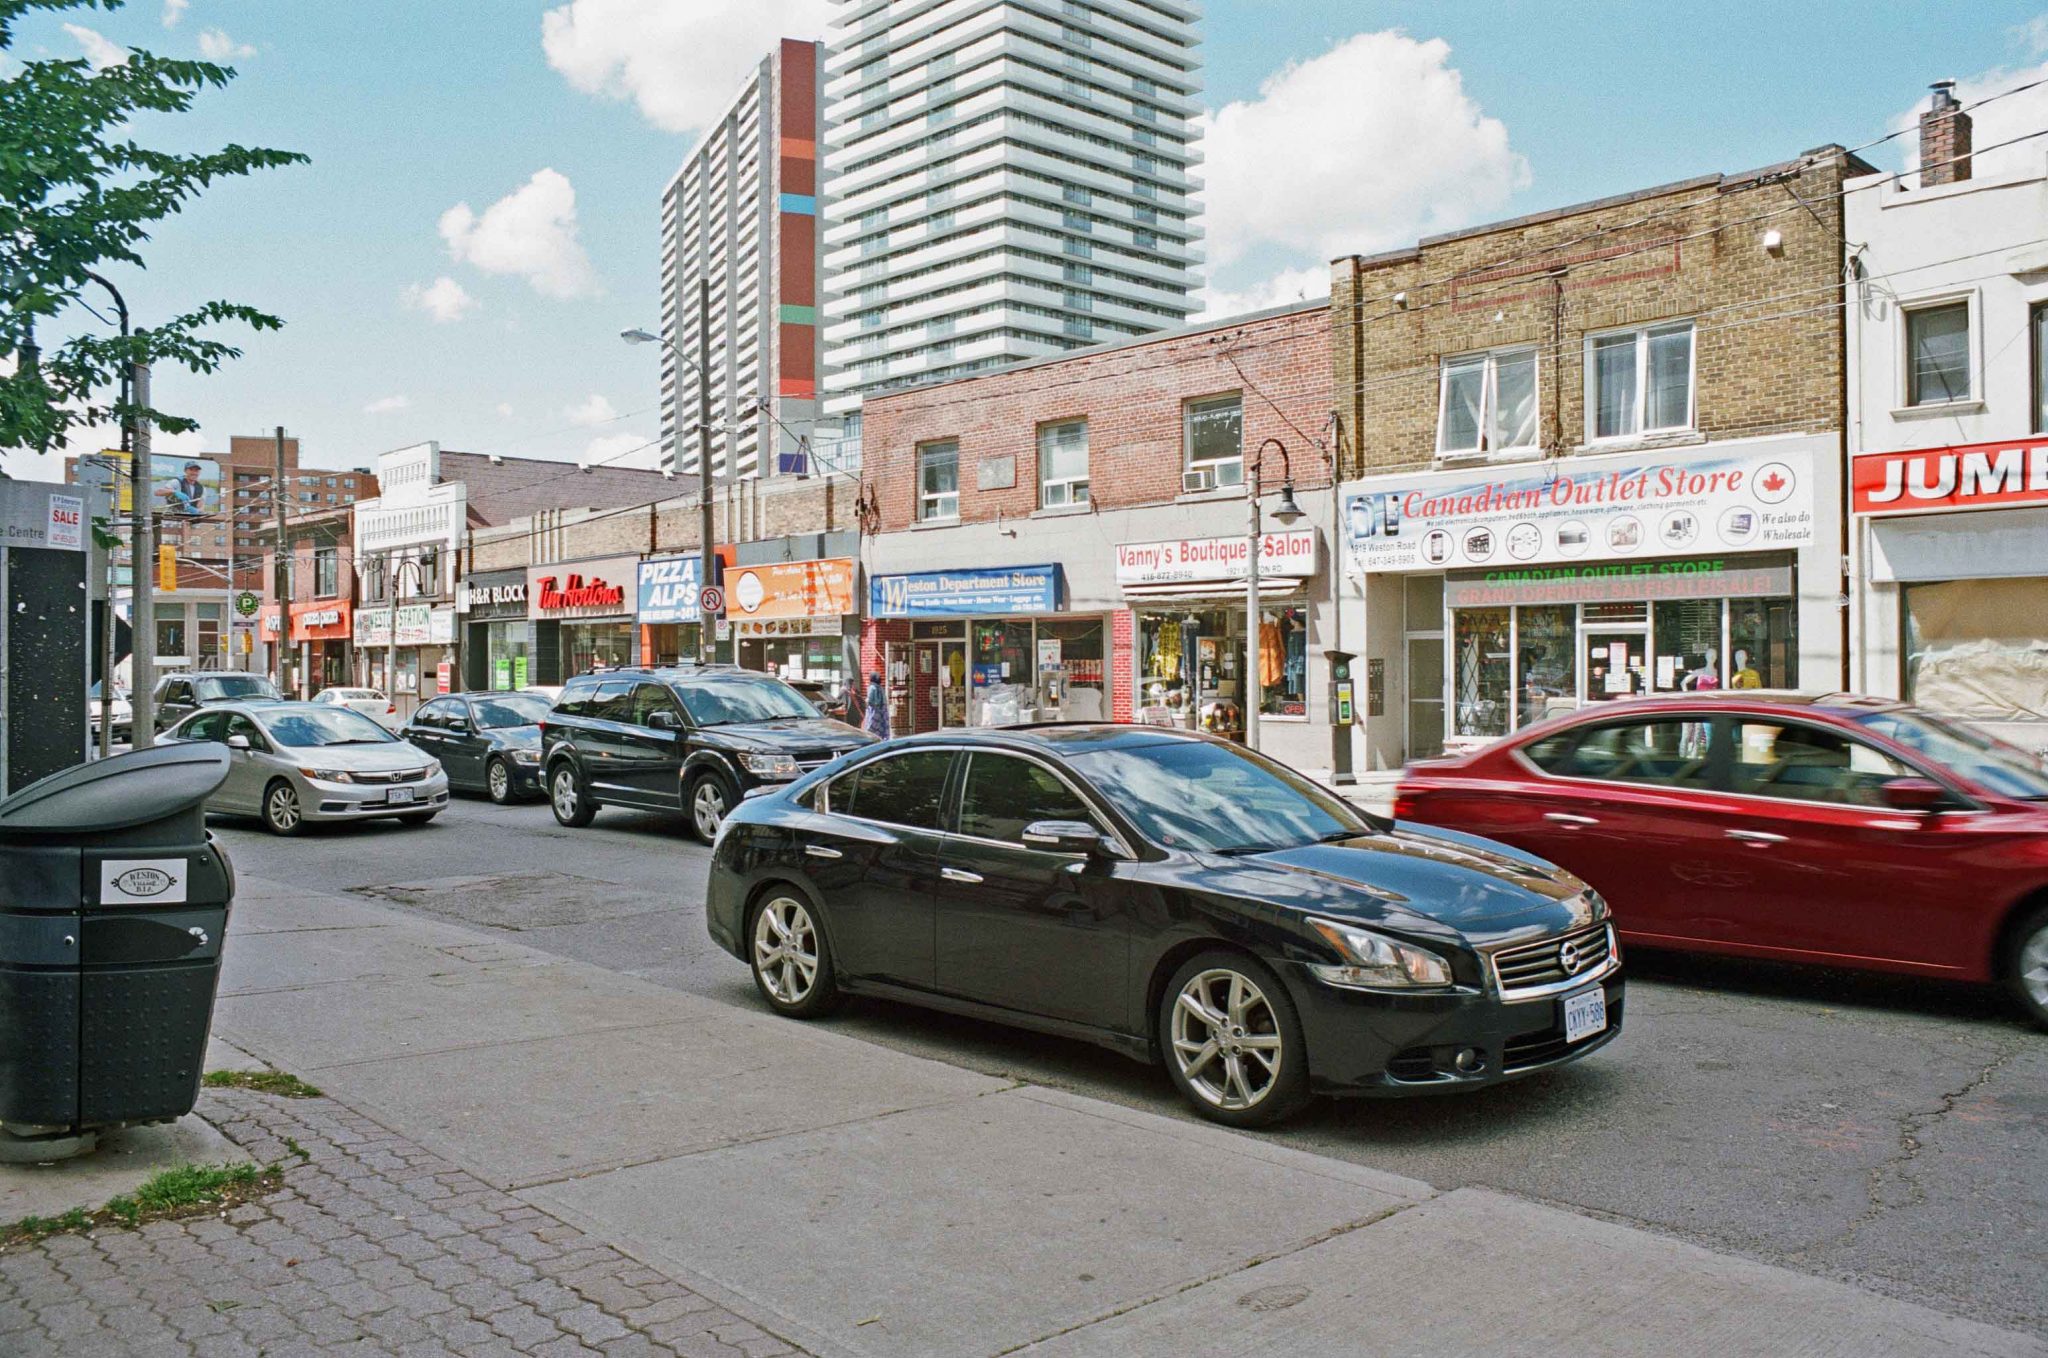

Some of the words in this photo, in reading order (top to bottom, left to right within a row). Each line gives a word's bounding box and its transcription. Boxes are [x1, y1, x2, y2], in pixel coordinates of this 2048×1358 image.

[1404, 484, 1541, 518] Canadian
[1551, 472, 1649, 506] Outlet
[1655, 467, 1743, 497] Store
[53, 510, 79, 525] SALE
[1762, 513, 1776, 524] We
[1779, 512, 1795, 523] also
[1798, 512, 1810, 522] do
[9, 525, 45, 539] Centre
[1763, 528, 1811, 541] Wholesale
[1119, 544, 1172, 569] Vanny's
[1180, 539, 1247, 566] Boutique
[1264, 533, 1311, 557] Salon
[1368, 543, 1394, 552] Weston
[1397, 540, 1416, 550] Road
[640, 560, 695, 585] PIZZA
[939, 574, 1008, 593] Department
[1012, 572, 1046, 586] Store
[1484, 567, 1577, 587] CANADIAN
[1582, 564, 1653, 582] OUTLET
[1658, 560, 1724, 579] STORE
[469, 588, 490, 605] H&R
[493, 584, 525, 602] BLOCK
[536, 576, 562, 609] Tim
[562, 573, 620, 608] Hortons
[648, 582, 699, 607] ALPS
[1457, 587, 1518, 604] GRAND
[1523, 583, 1604, 600] OPENING
[370, 610, 392, 628] WEST
[399, 607, 430, 627] STATION
[1284, 704, 1305, 714] OPEN
